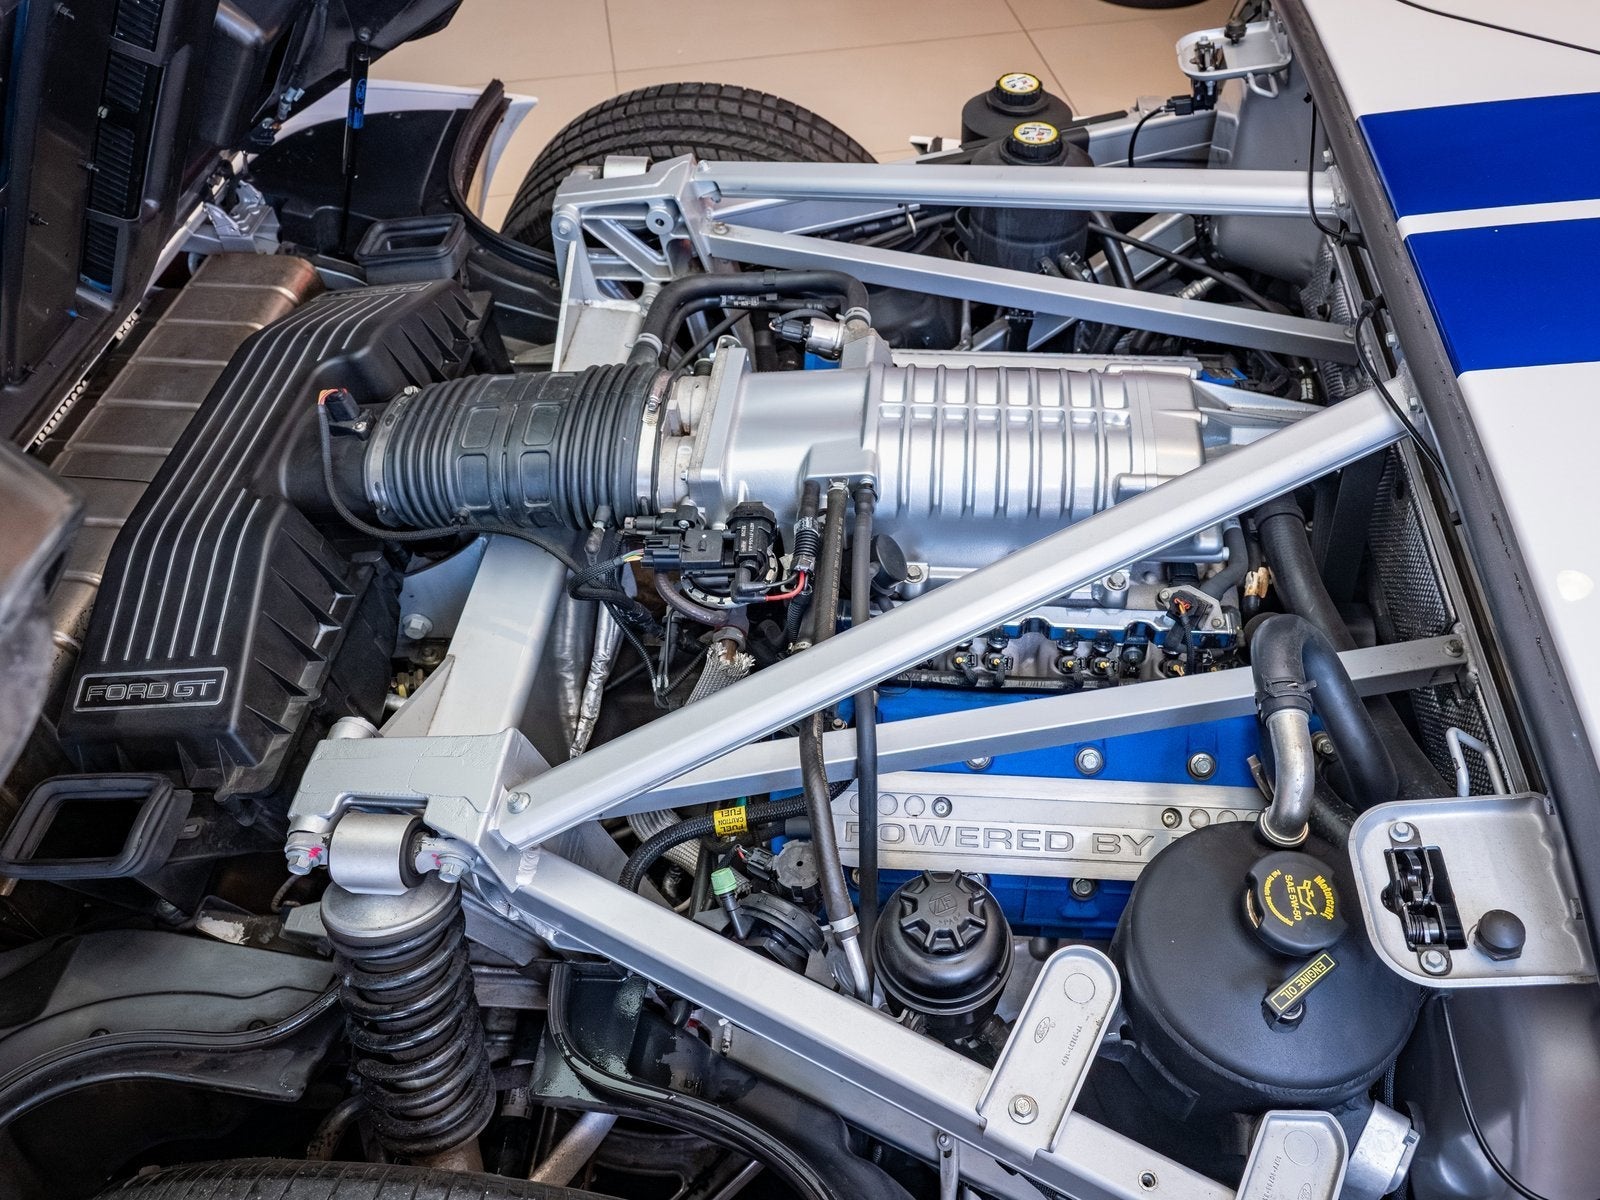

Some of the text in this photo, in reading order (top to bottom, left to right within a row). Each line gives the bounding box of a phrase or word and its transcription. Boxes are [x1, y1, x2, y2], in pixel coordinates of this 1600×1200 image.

[85, 679, 217, 702] FORD GT
[720, 824, 744, 832] FUEL
[721, 808, 741, 817] FUEL
[845, 821, 1155, 857] POWERED BY
[1285, 874, 1303, 921] SAE 5W-50
[1313, 875, 1335, 920] Motorcraft
[1280, 961, 1327, 1000] ENGINE OIL
